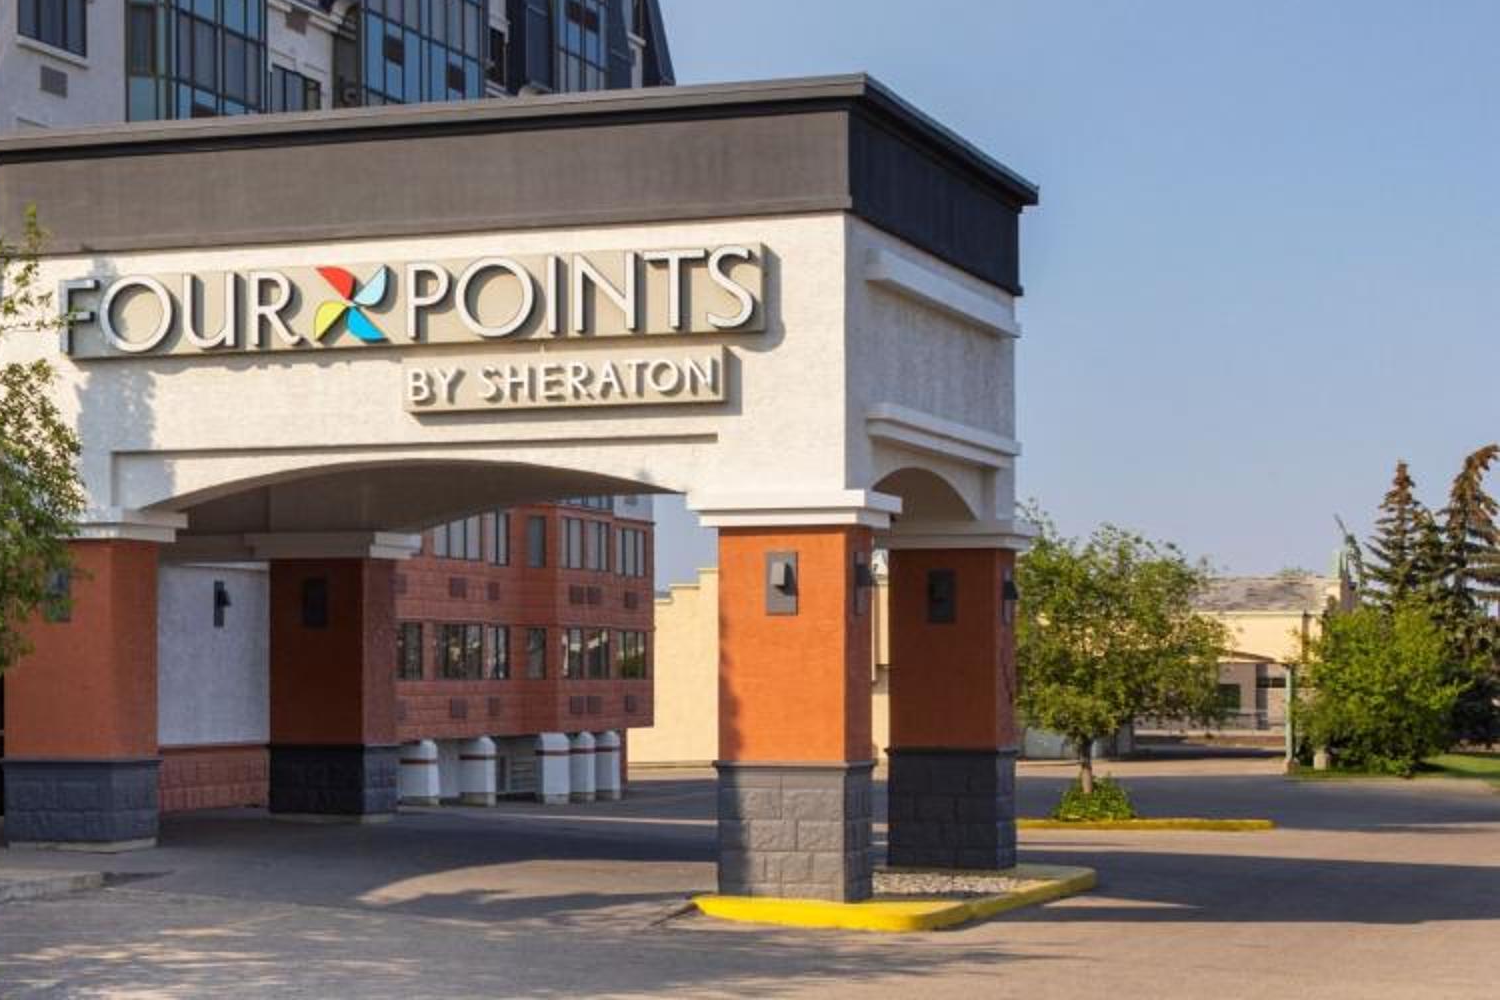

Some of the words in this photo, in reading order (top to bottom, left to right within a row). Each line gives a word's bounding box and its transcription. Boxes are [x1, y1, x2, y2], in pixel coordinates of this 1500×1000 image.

[59, 270, 303, 356] FOUR
[406, 245, 756, 339] POINTS
[409, 364, 463, 405] BY
[479, 356, 719, 403] SHERATON
